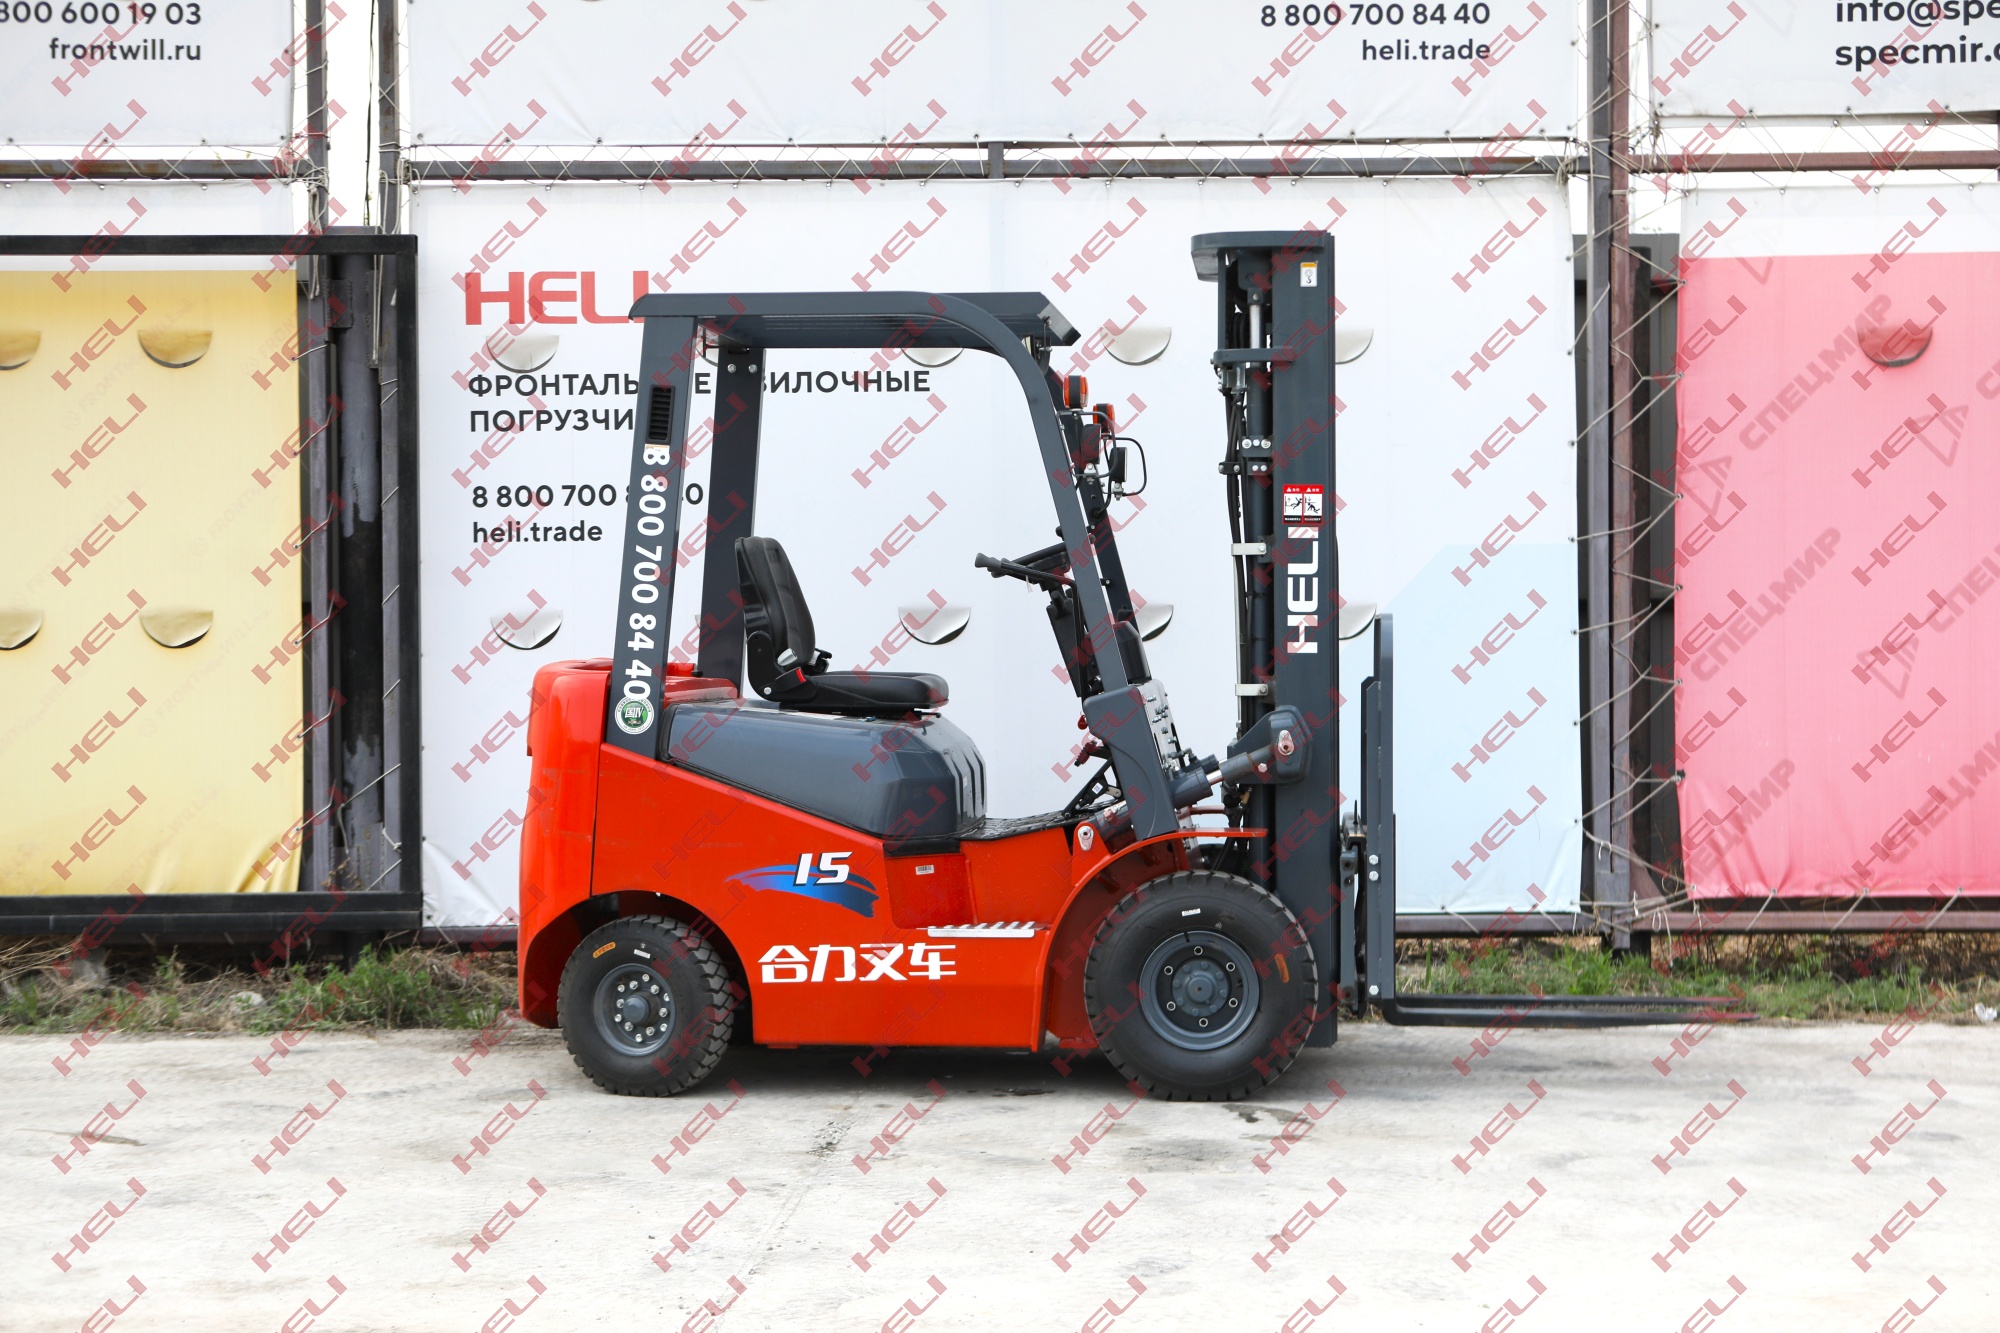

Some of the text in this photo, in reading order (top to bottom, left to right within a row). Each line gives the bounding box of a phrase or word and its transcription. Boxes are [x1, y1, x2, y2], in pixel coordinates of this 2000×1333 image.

[61, 2, 120, 25] 600
[129, 2, 157, 25] 19
[165, 2, 202, 25] 03
[1261, 3, 1491, 27] 8 800 700 84 40
[49, 37, 202, 61] frontwill.ru
[1362, 38, 1491, 61] heli.trade
[763, 370, 931, 394] ИЛОЧНЫЕ
[1738, 294, 1892, 451] СПЕЦМИР
[470, 408, 634, 432] ПОГРУЗЧИ
[643, 447, 671, 466] 8
[472, 485, 488, 508] 8
[496, 485, 554, 508] 800
[561, 484, 617, 507] 700
[637, 474, 668, 537] 800
[473, 520, 603, 543] heli.trade
[631, 545, 663, 604] 700
[1286, 526, 1319, 654] HELI
[1690, 526, 1842, 682] СПЕЦМИР
[627, 612, 657, 652] 84
[623, 659, 653, 700] 40
[793, 851, 854, 887] 15
[758, 942, 957, 984] 合力叉车
